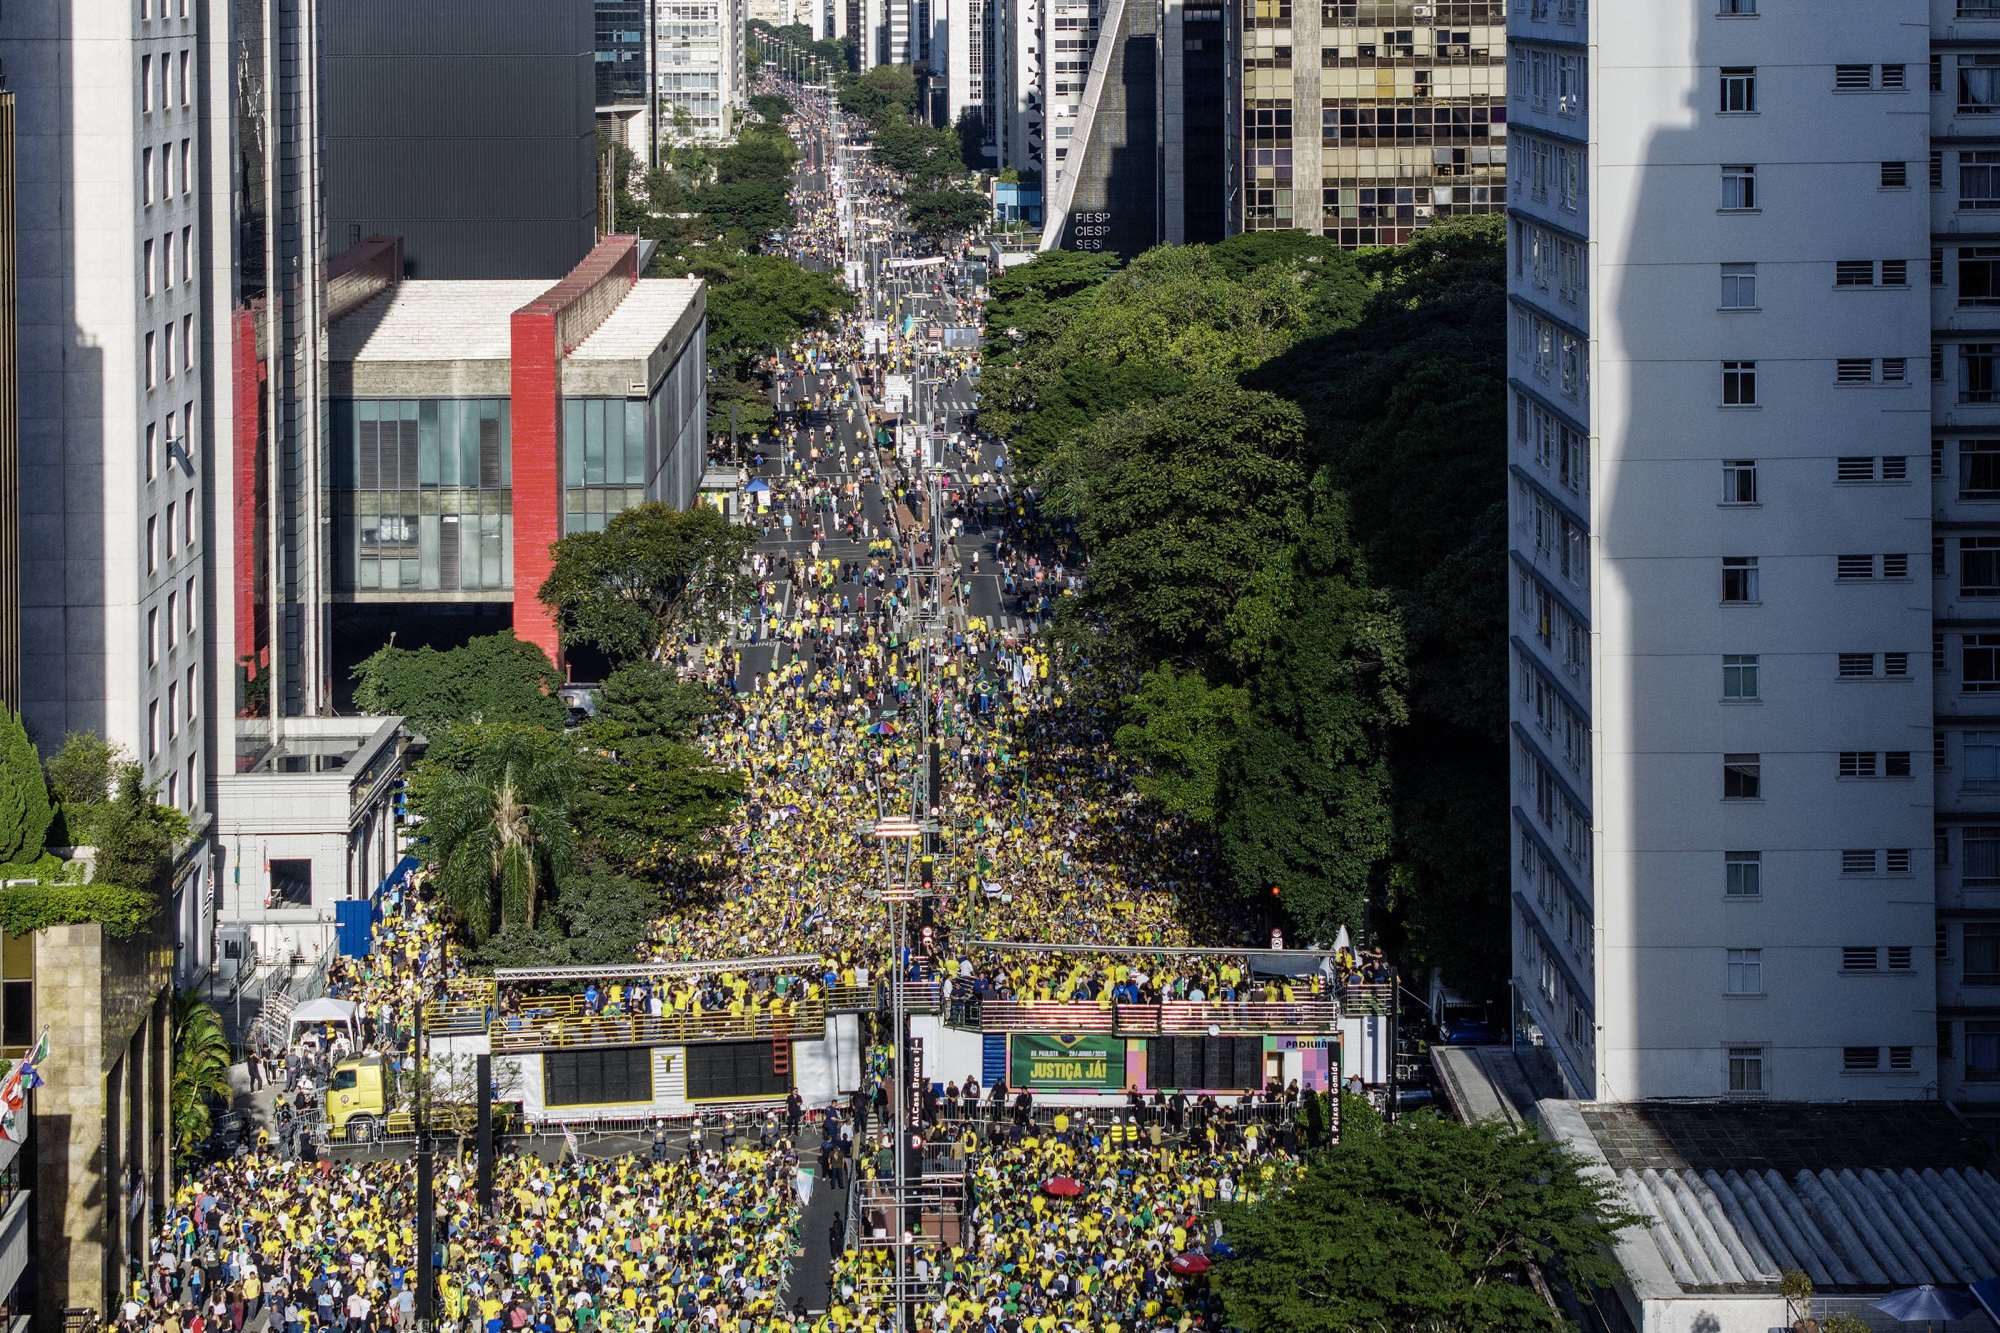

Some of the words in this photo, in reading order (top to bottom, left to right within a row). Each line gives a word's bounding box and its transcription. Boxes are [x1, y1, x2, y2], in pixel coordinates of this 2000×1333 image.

[1075, 213, 1111, 223] FIESP
[1075, 226, 1111, 236] CIESP
[1076, 239, 1103, 250] SESI
[912, 1057, 920, 1088] Branca
[1030, 1062, 1082, 1080] JUSTIÇA
[1085, 1060, 1107, 1078] JÁ!
[1331, 1061, 1339, 1094] Gomide
[1331, 1097, 1339, 1132] Peixoto
